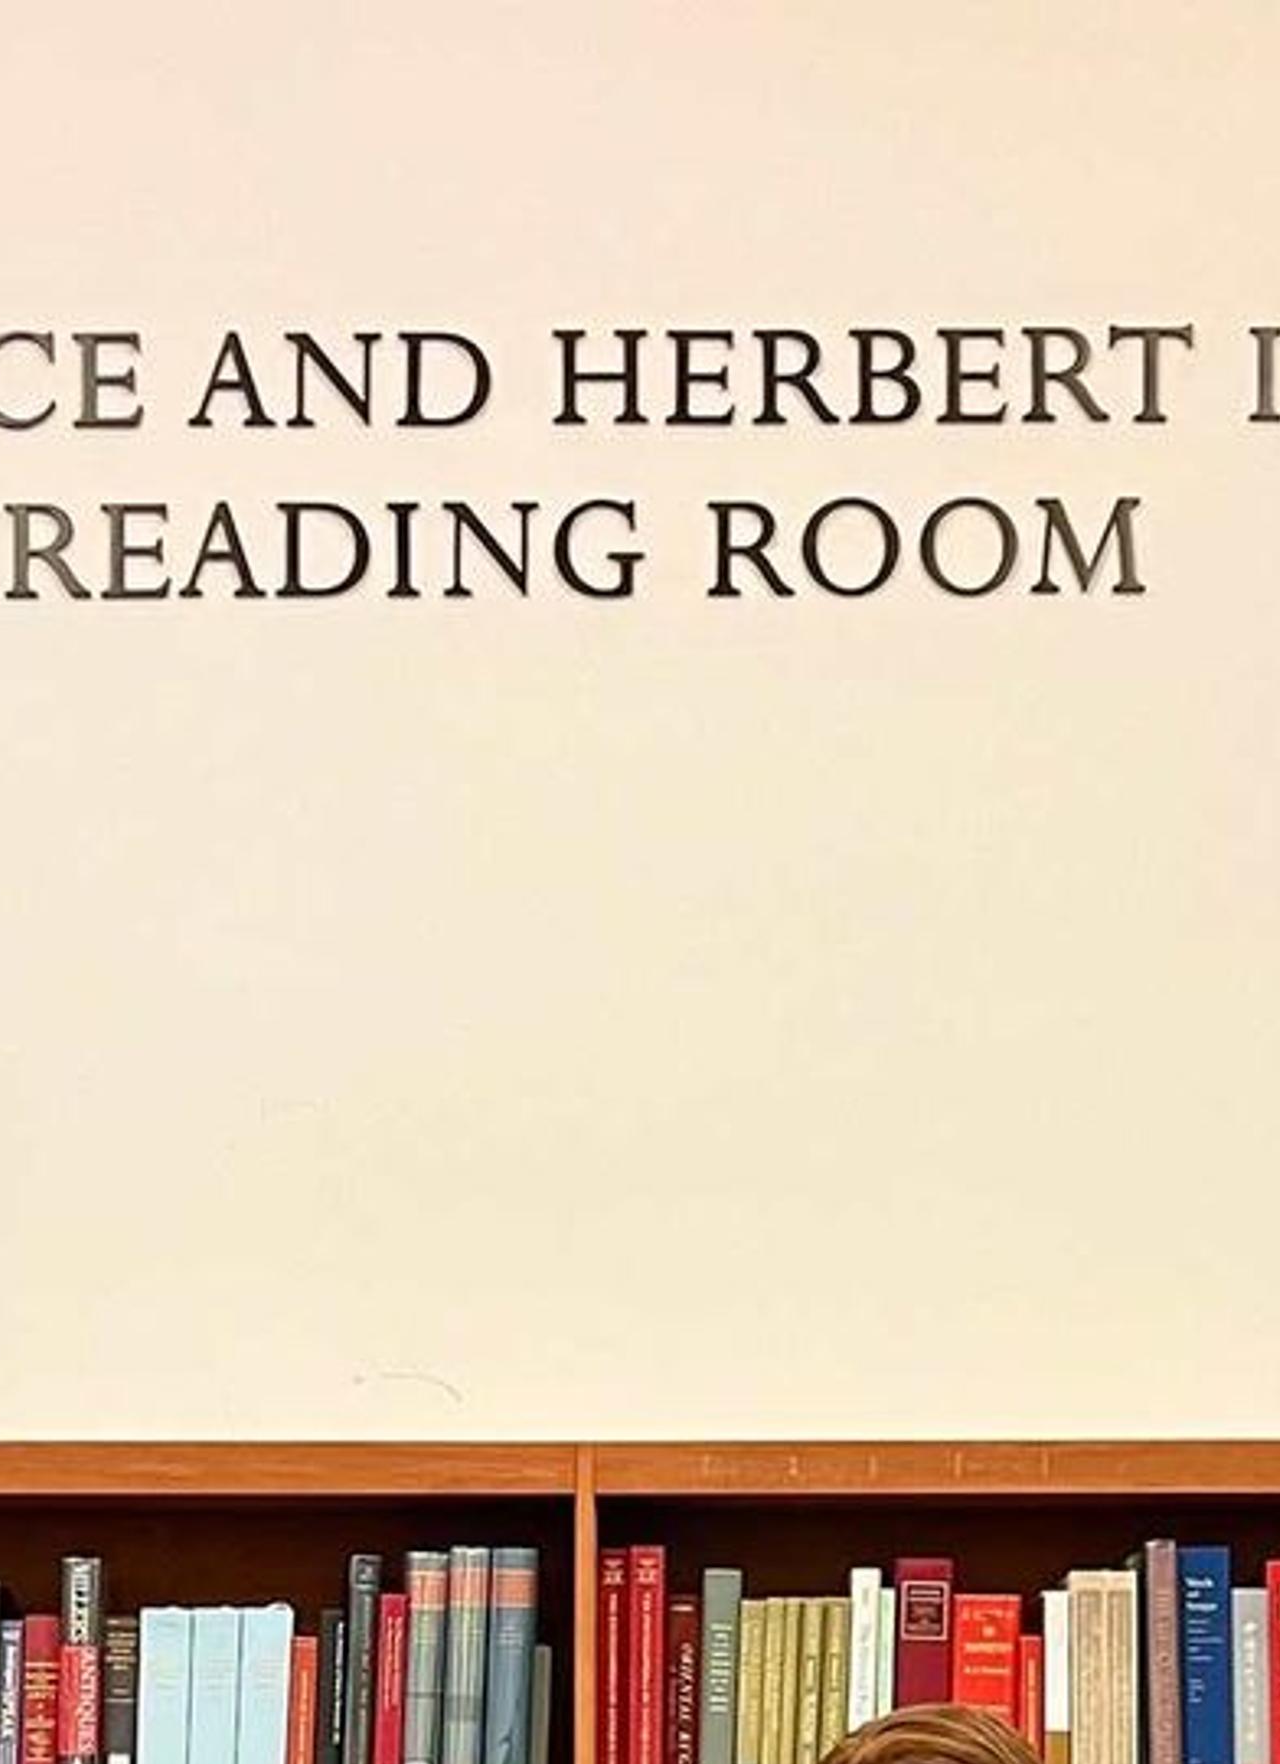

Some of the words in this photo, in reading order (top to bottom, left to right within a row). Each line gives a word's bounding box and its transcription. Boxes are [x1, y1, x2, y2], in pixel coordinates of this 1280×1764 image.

[187, 329, 492, 429] AND
[551, 323, 1194, 427] HERBERT
[3, 499, 646, 601] READING
[706, 496, 1147, 598] ROOM
[76, 1646, 98, 1755] ANTIQUES
